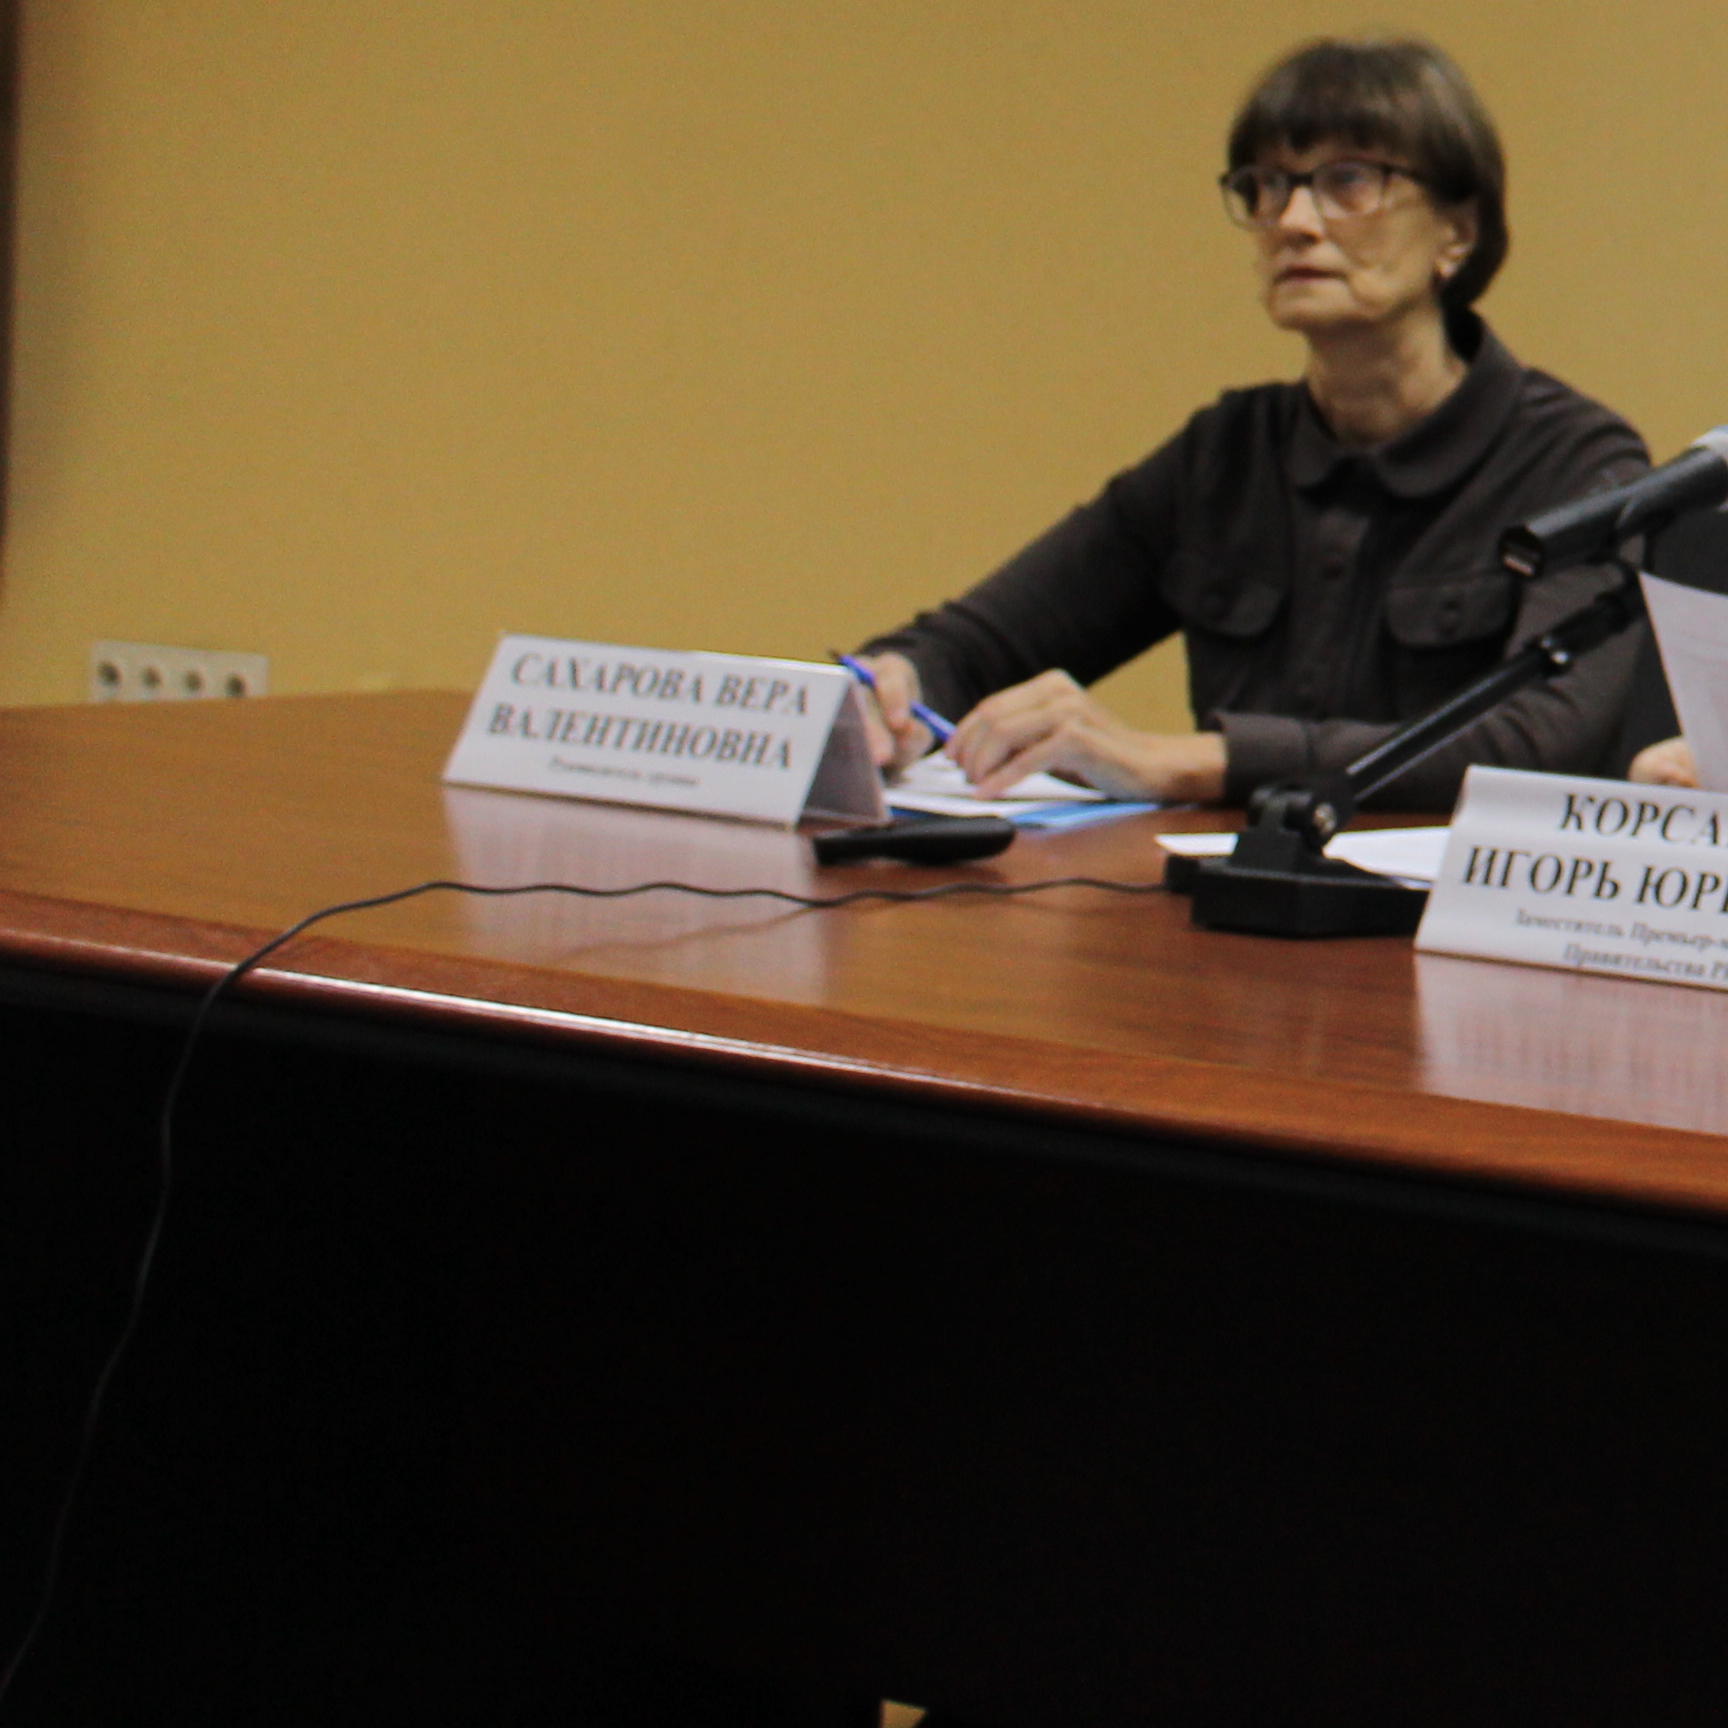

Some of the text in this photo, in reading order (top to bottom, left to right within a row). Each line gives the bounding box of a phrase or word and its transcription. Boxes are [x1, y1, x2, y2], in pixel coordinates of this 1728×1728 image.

[511, 650, 809, 716] САХАРОВА ВЕРА
[486, 702, 794, 771] ВАЛЕНТИНОВНА
[1461, 845, 1623, 902] ИГОРЬ
[1515, 907, 1624, 938] Заместитель
[1562, 943, 1706, 977] Правительства
